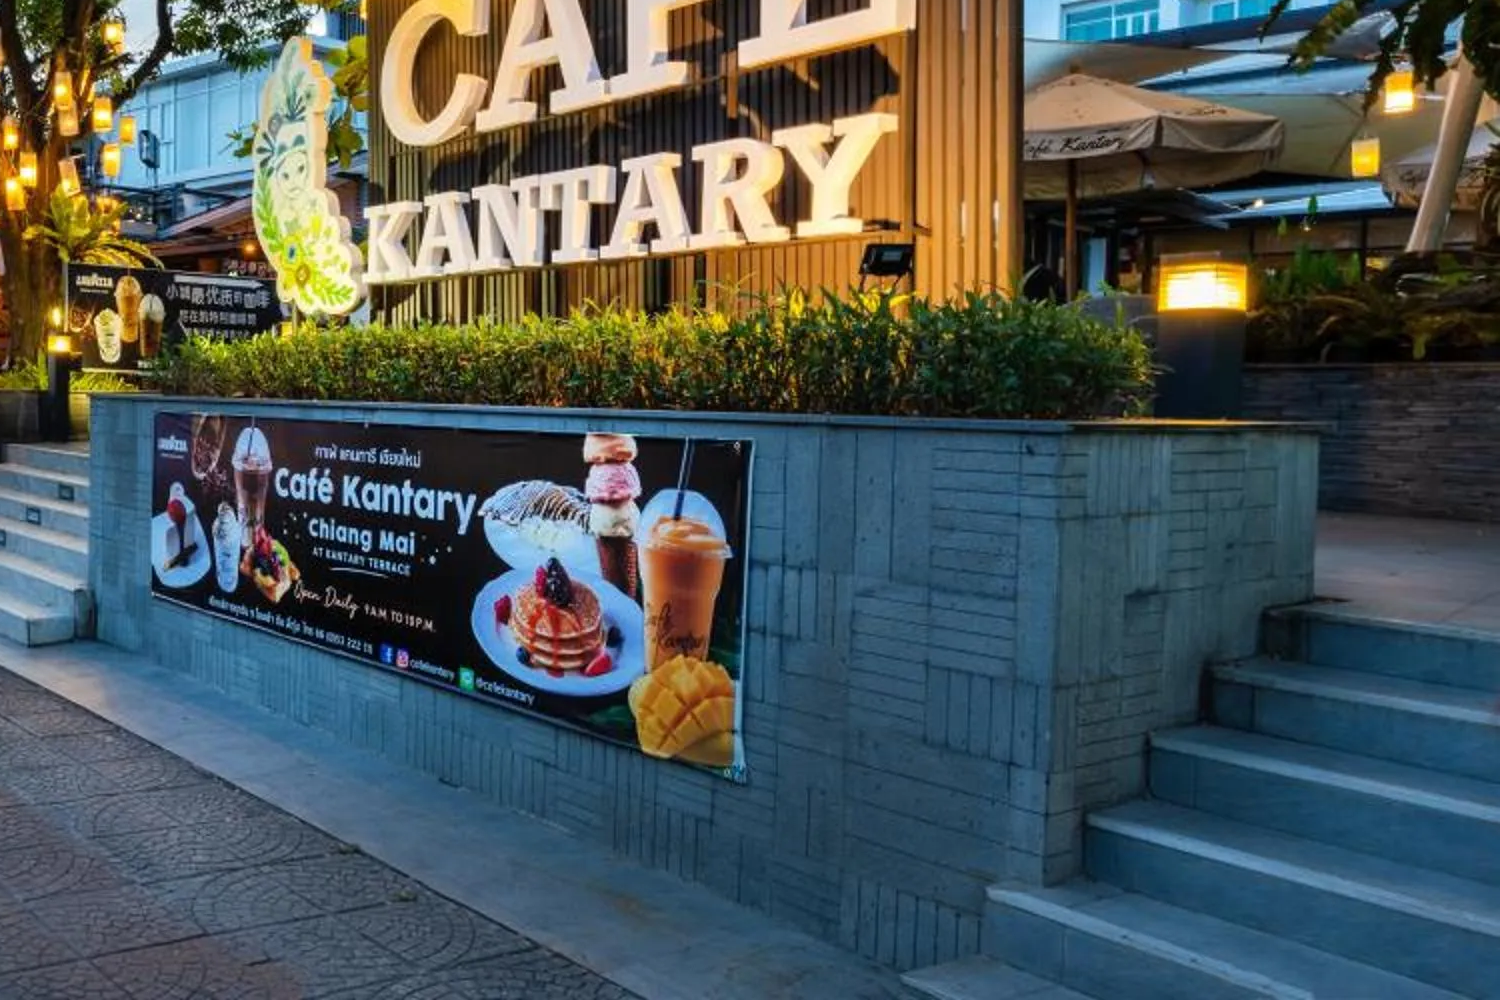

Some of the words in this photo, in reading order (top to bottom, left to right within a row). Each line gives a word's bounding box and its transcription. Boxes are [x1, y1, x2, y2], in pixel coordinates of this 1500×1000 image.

[1025, 138, 1052, 158] afé
[364, 112, 898, 283] KANTARY
[275, 466, 334, 504] Café
[342, 474, 477, 535] Kantary
[308, 517, 373, 552] Chiang
[379, 529, 416, 556] Mai
[312, 547, 323, 557] AT
[325, 549, 365, 567] KANTARY
[368, 557, 411, 576] TERRACE
